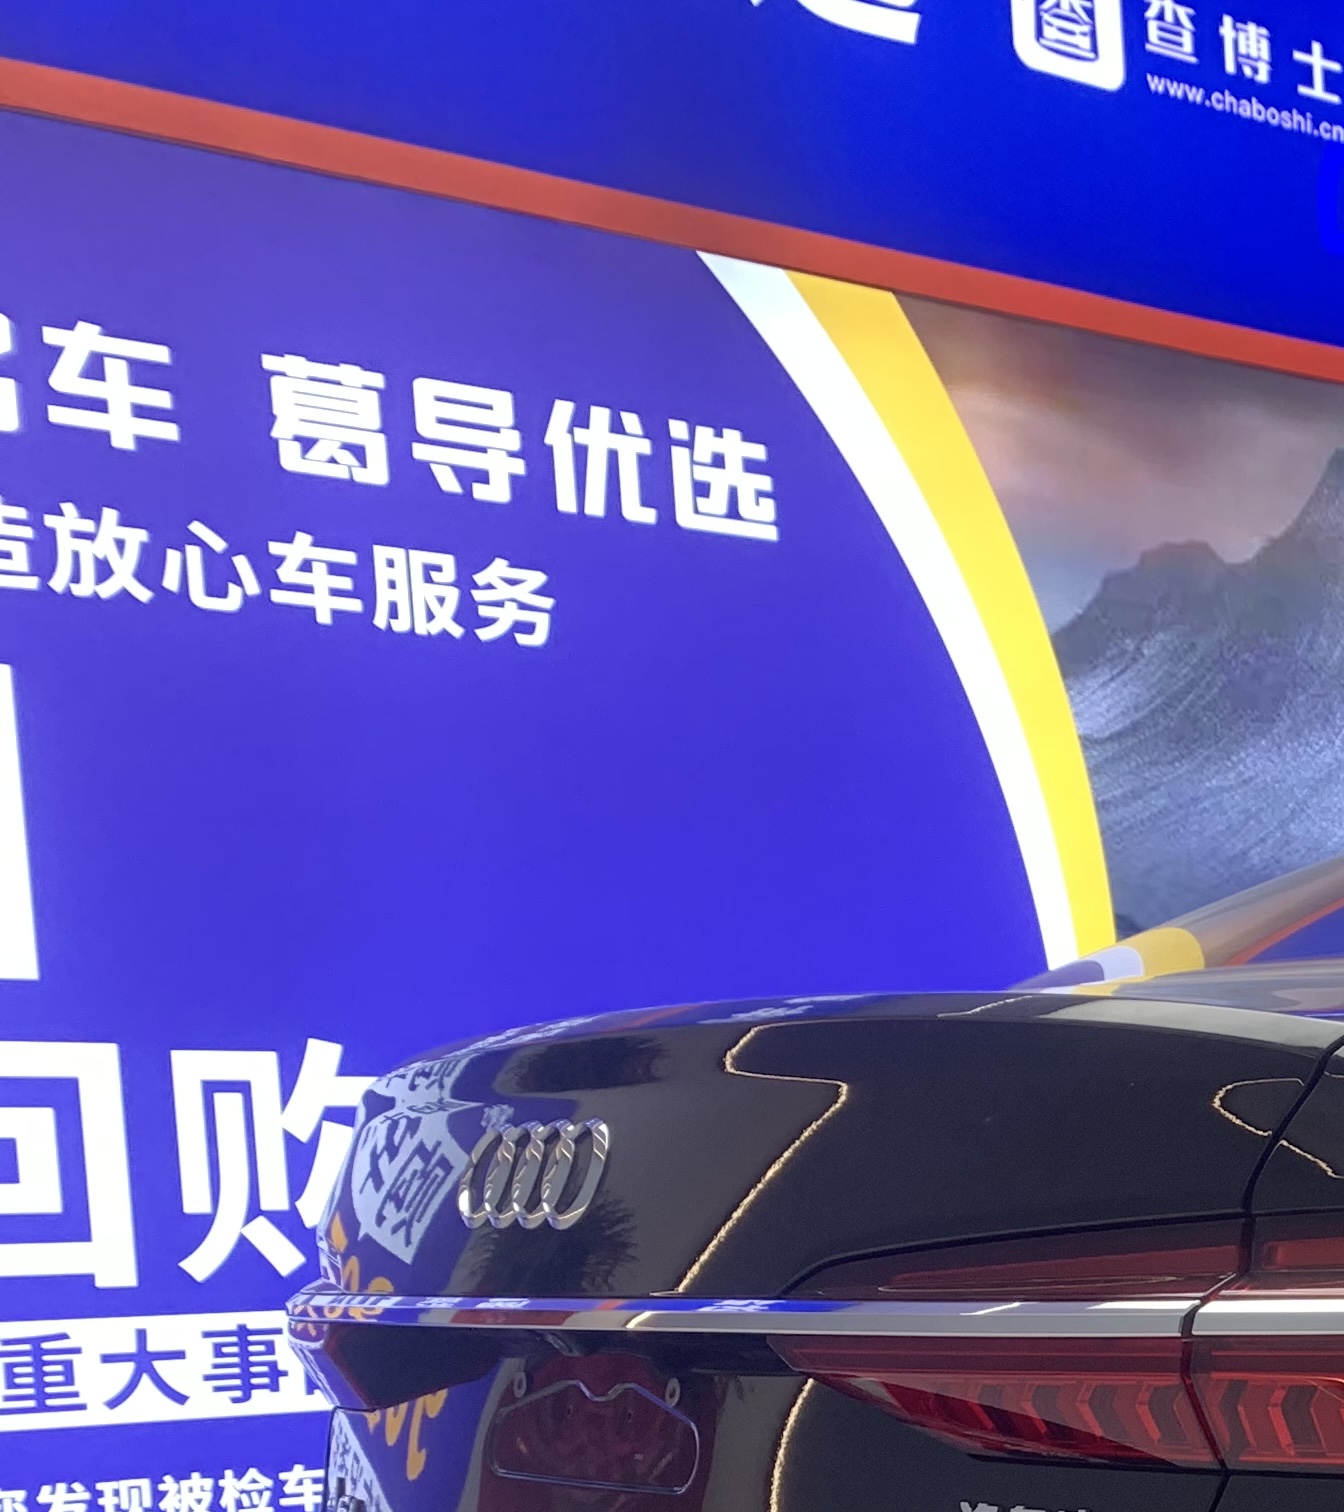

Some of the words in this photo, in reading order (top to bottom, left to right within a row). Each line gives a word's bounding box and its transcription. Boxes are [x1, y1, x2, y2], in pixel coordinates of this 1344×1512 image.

[1144, 0, 1342, 104] 查博士
[261, 353, 780, 541] 葛导优选
[0, 1323, 322, 1415] 重大事
